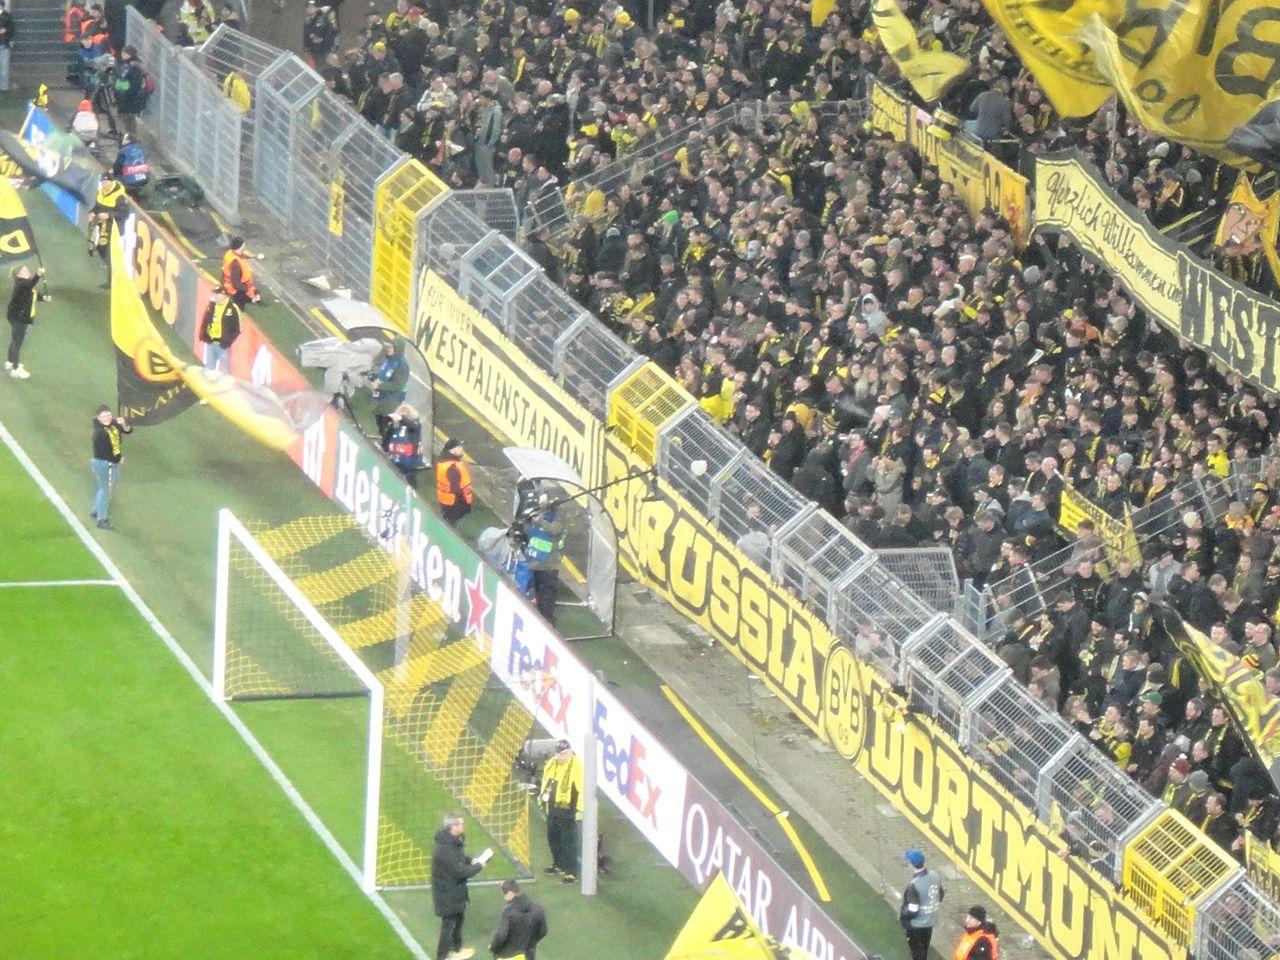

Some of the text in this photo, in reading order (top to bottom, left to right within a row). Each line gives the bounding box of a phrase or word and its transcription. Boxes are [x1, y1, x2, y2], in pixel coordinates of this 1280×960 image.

[416, 311, 585, 478] WESTFALENSTADION
[603, 444, 821, 718] BORUSSIA
[829, 652, 861, 736] BVB
[593, 697, 663, 831] FedEx
[685, 803, 772, 941] QATAR
